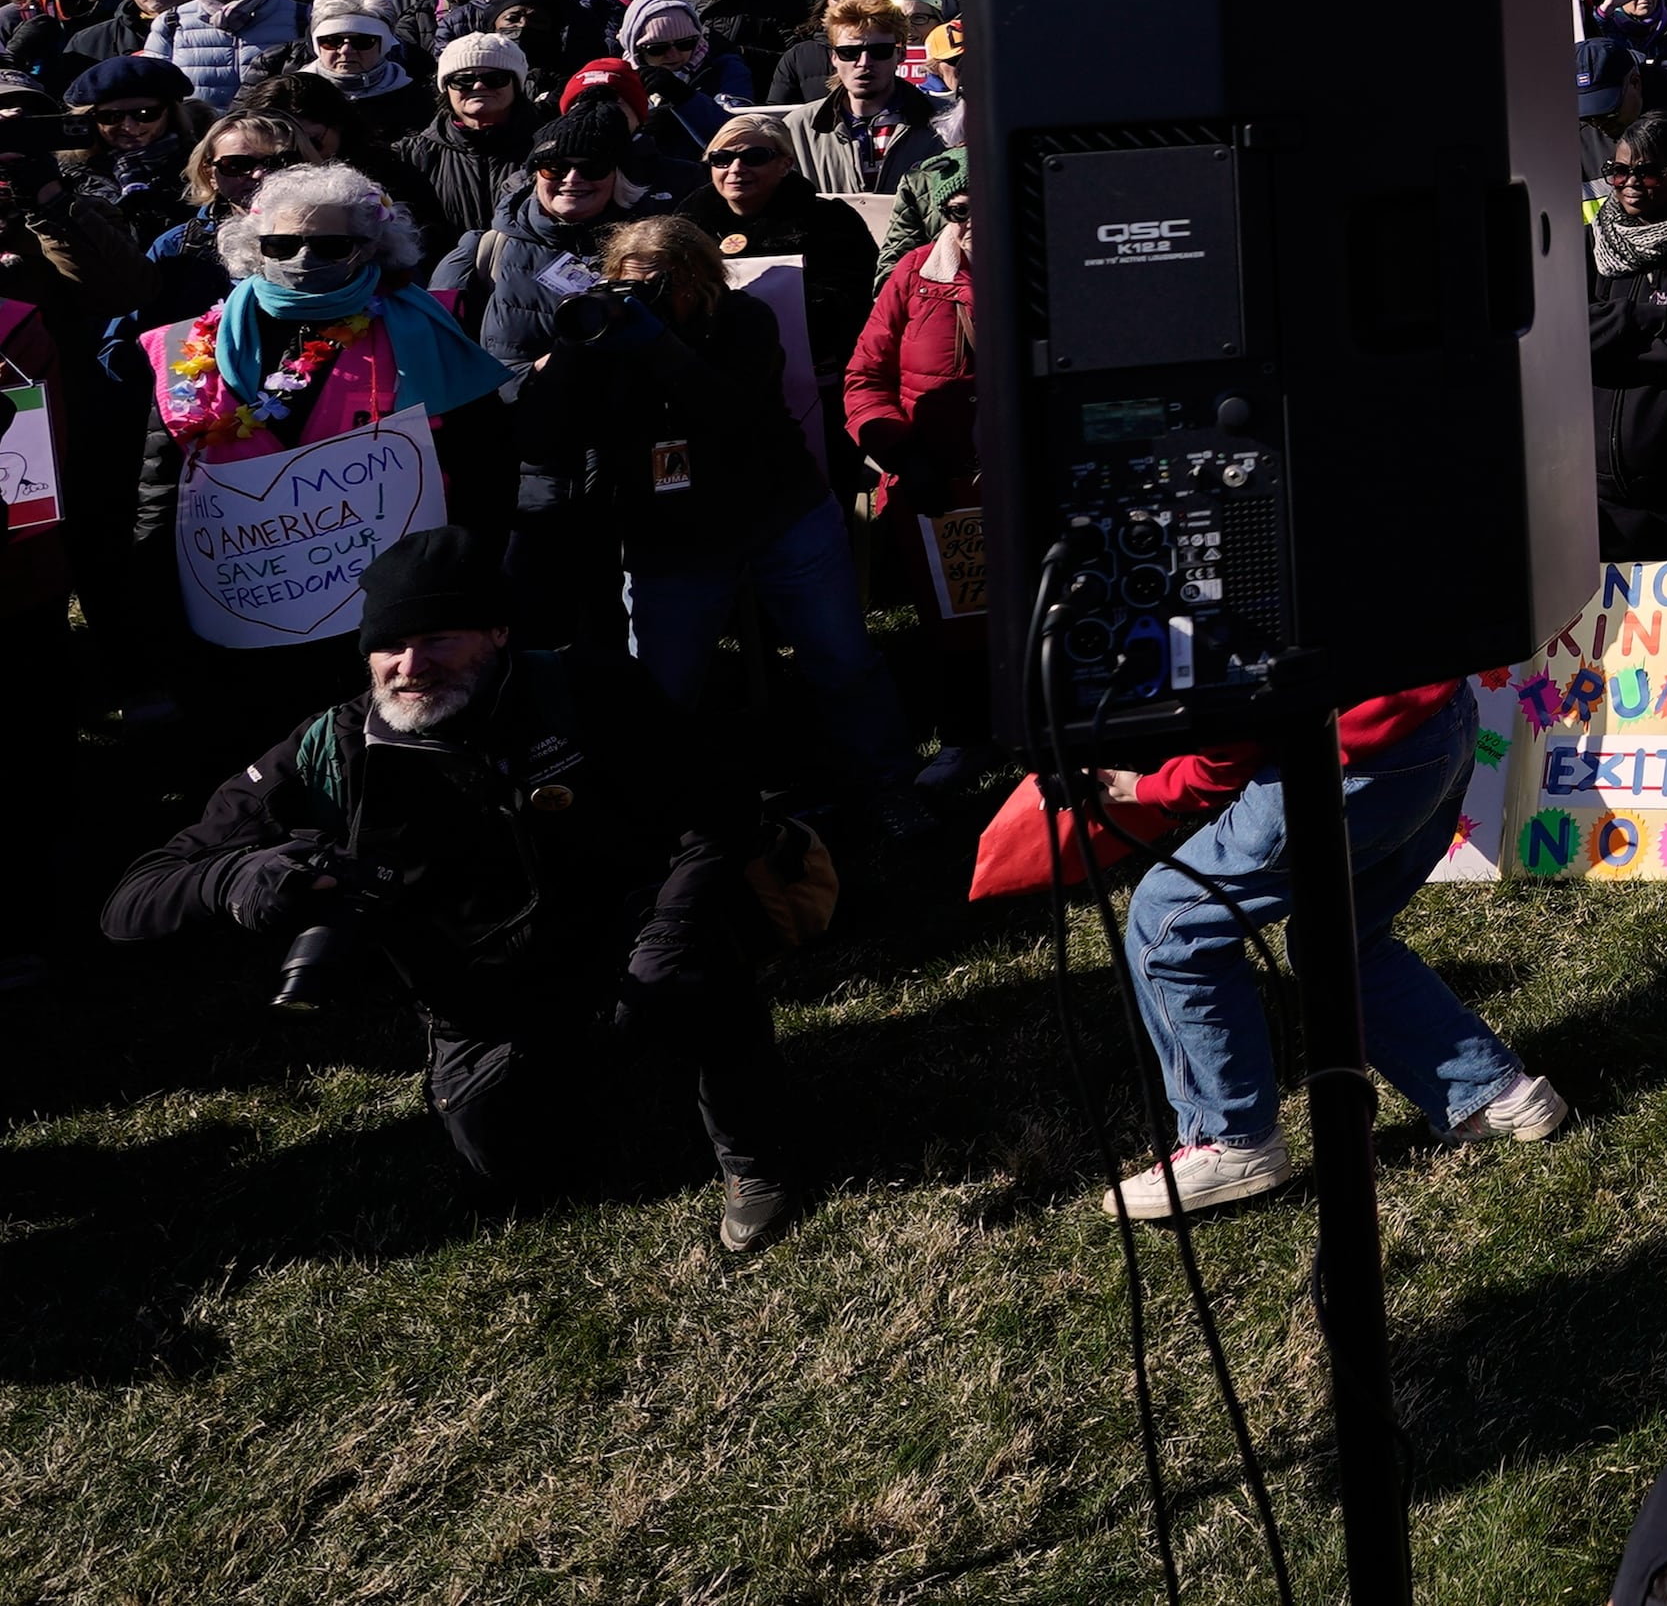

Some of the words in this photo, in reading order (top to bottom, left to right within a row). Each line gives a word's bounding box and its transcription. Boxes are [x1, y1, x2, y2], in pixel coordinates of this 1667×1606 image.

[1097, 219, 1191, 242] QSC
[1117, 241, 1171, 255] K12.2
[1148, 251, 1205, 261] LOUDSPEAKER
[292, 447, 403, 507] MOM
[656, 473, 688, 486] ZUMA
[189, 490, 224, 518] THIS
[222, 500, 363, 555] AMERICA
[217, 555, 286, 585] SAVE
[308, 527, 382, 565] OUR
